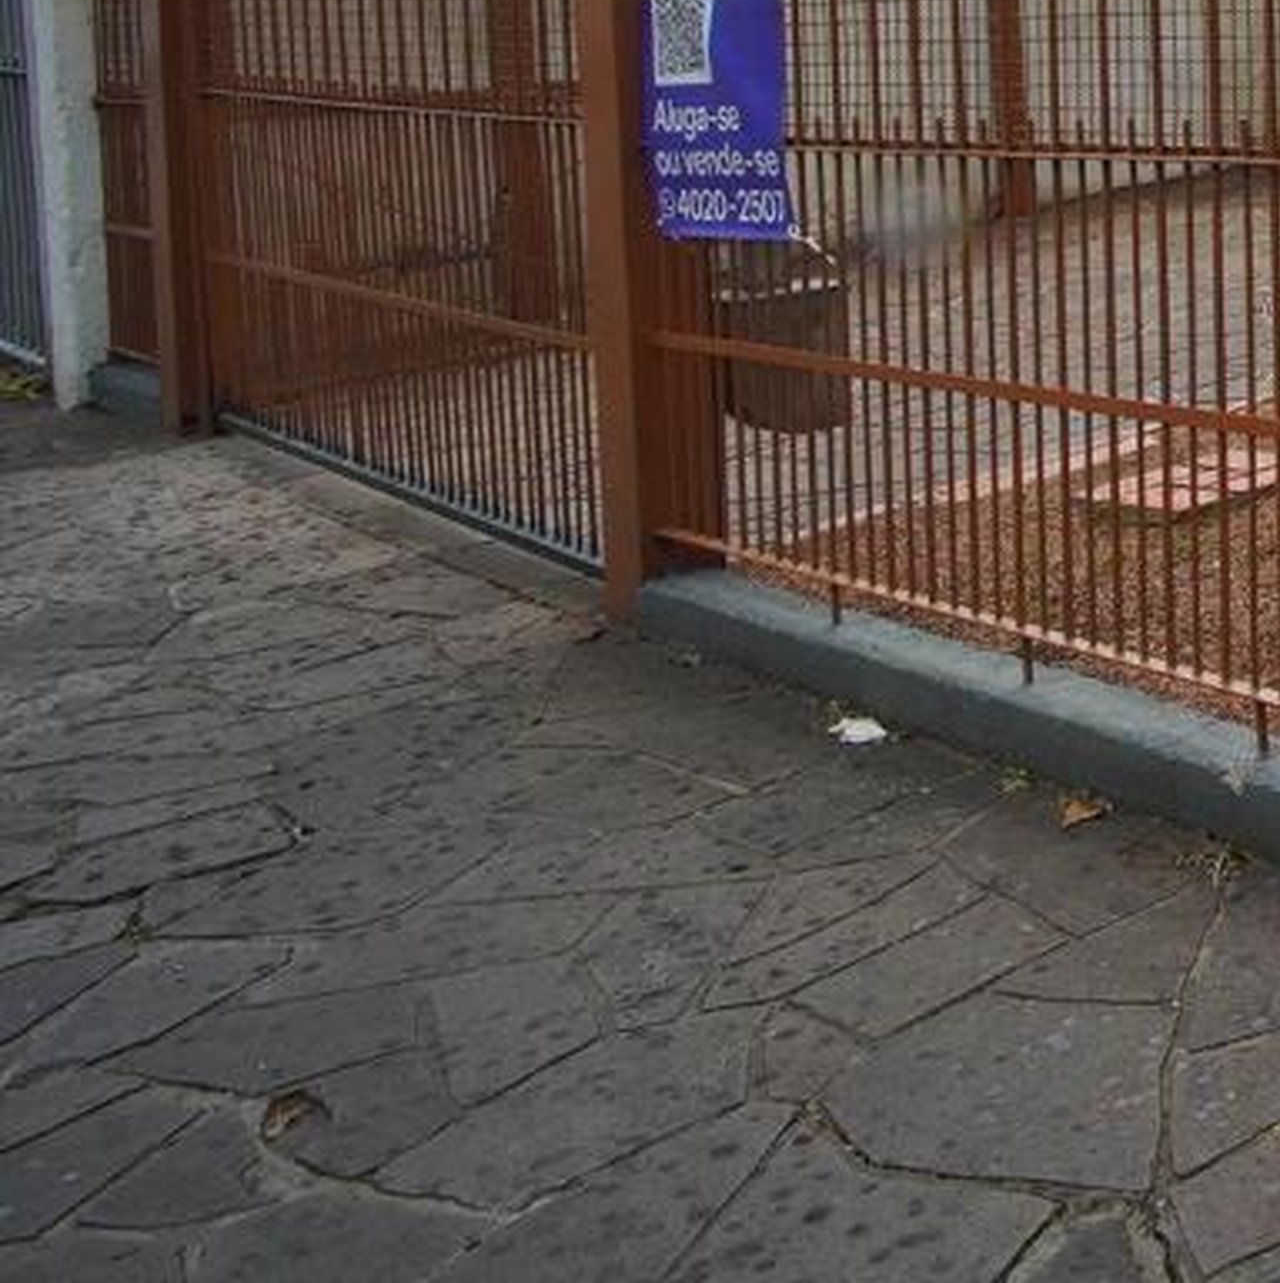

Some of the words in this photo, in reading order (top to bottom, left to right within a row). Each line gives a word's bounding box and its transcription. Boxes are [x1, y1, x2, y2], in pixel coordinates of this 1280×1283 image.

[654, 99, 741, 141] Aluga-se
[655, 150, 682, 177] ou
[682, 143, 780, 176] vende-se
[677, 189, 785, 223] 4020-2507
